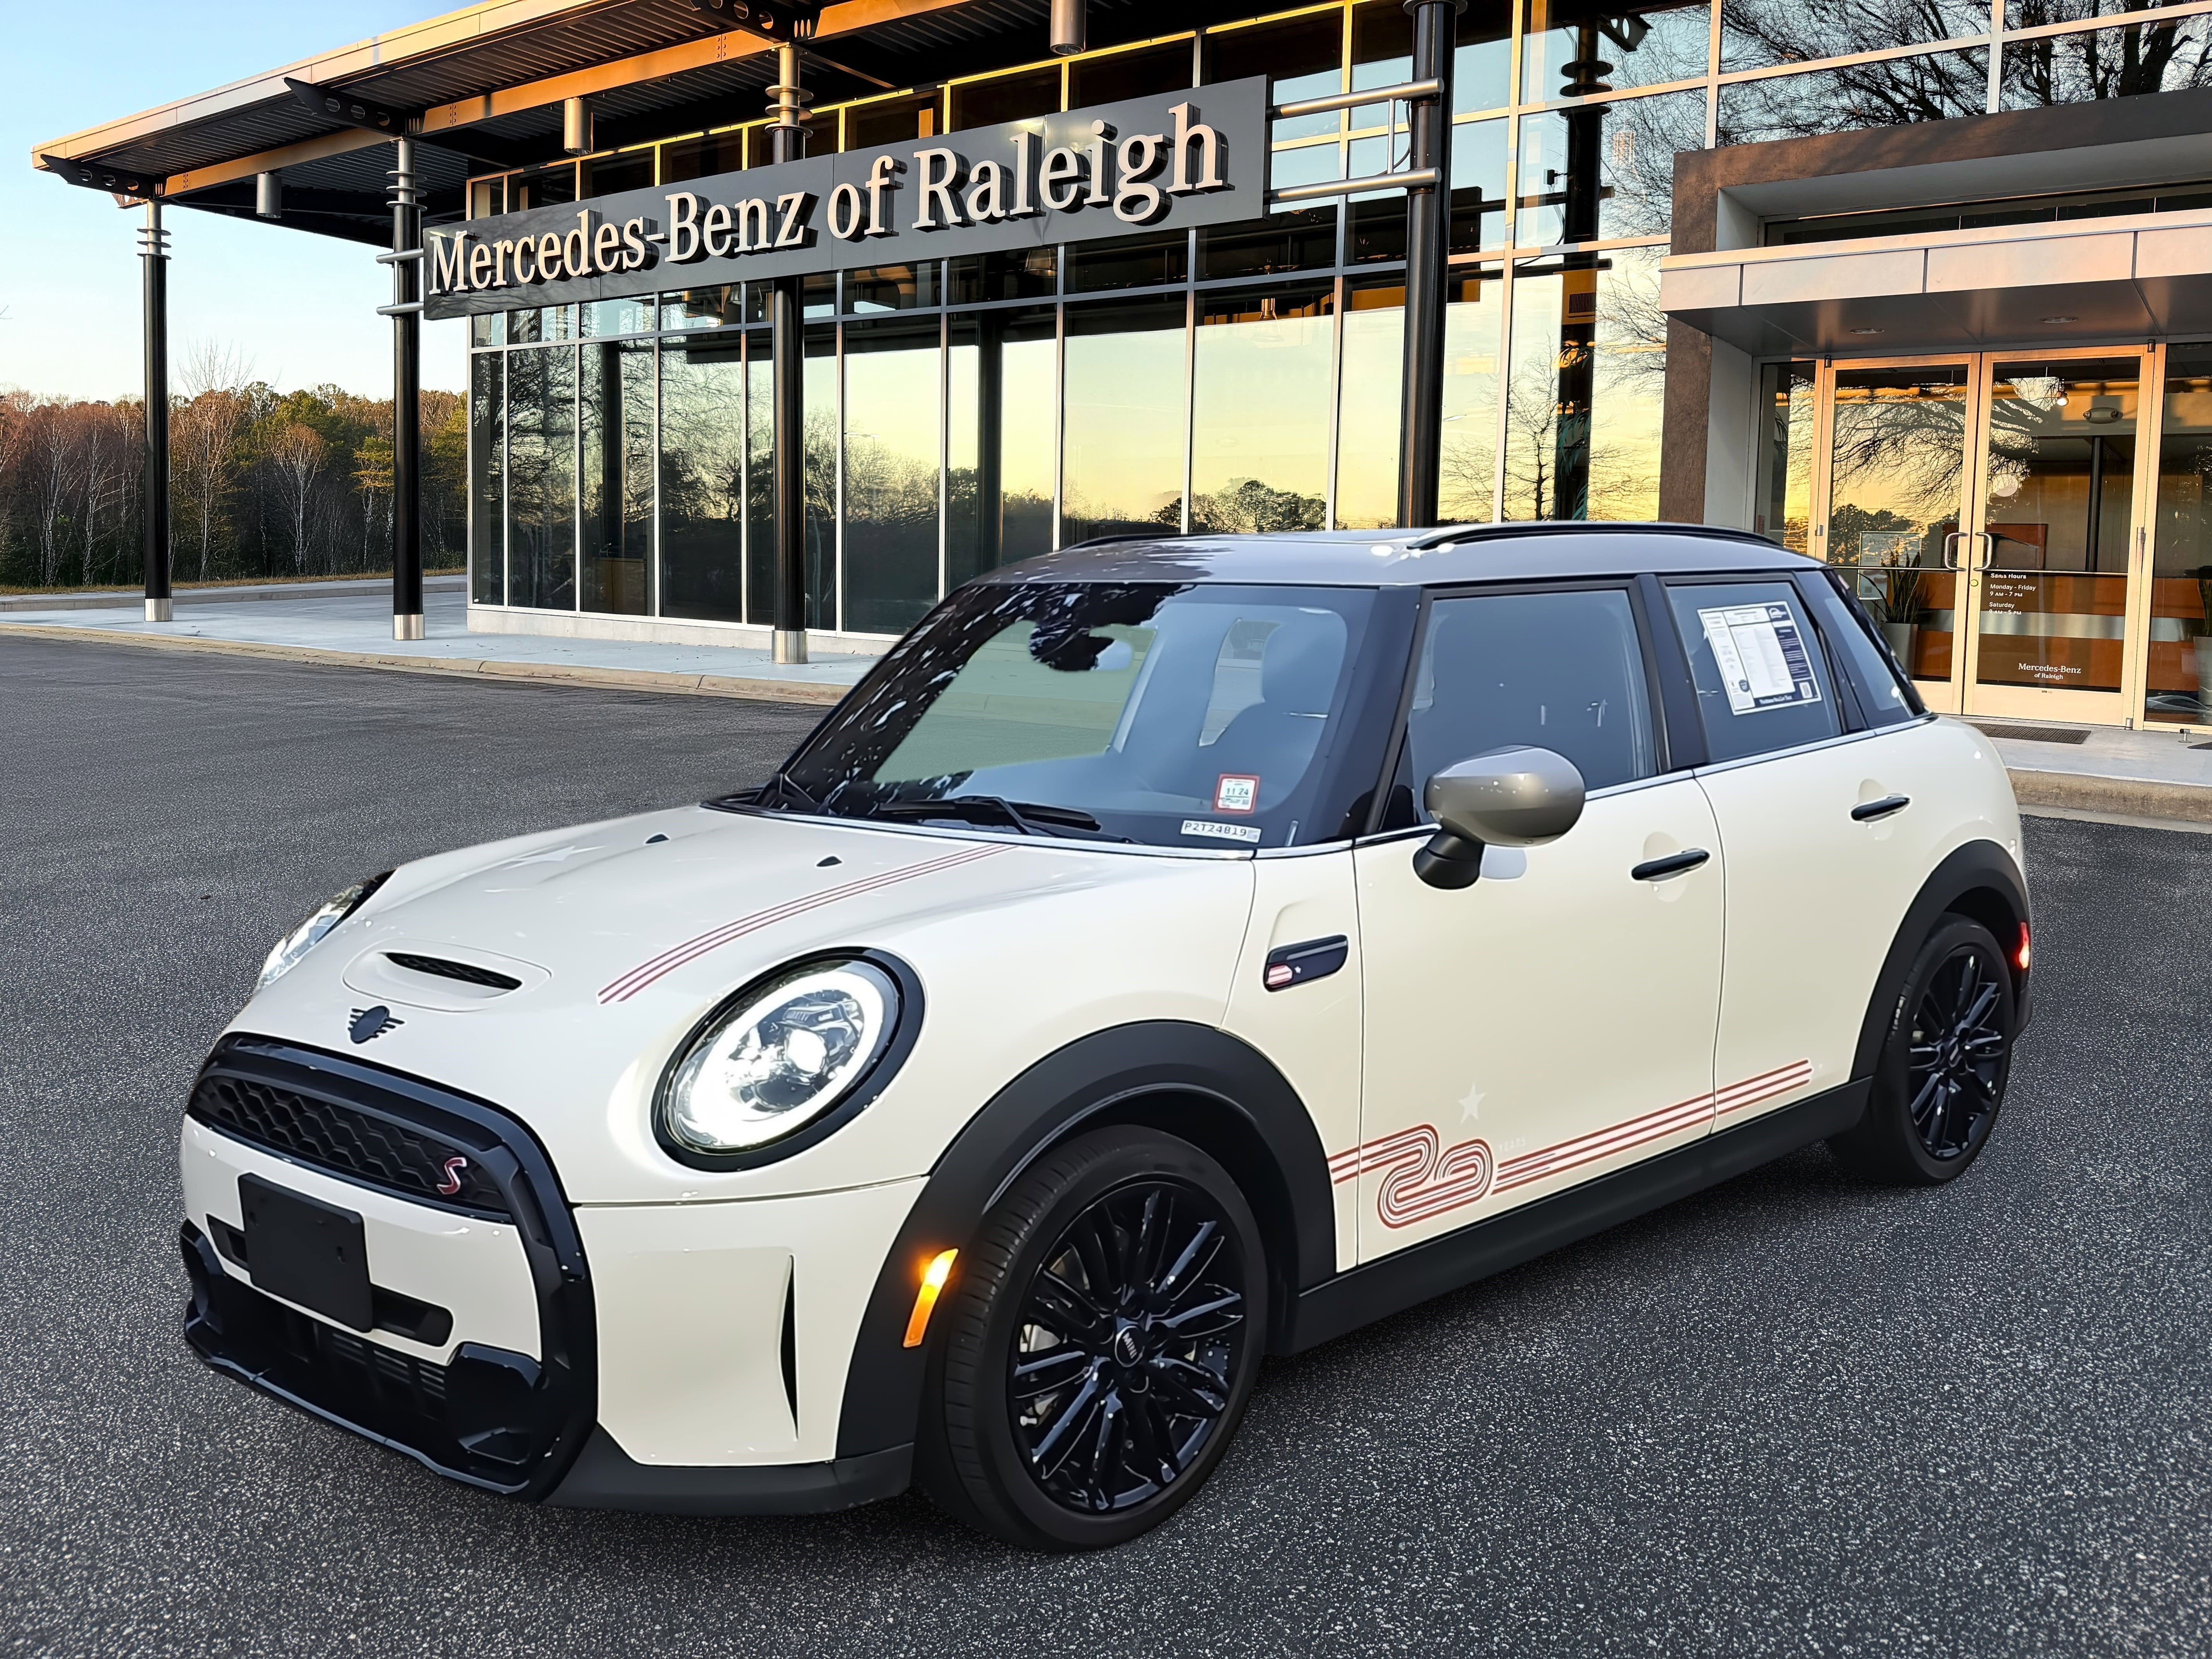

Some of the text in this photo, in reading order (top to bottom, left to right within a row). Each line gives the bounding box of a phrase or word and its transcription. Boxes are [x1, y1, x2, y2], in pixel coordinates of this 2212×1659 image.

[429, 102, 1224, 295] Mercedes-Benz of Raleigh
[2018, 663, 2081, 674] Mercedes-Benz
[436, 1157, 467, 1195] S
[1122, 1331, 1138, 1359] MINI
